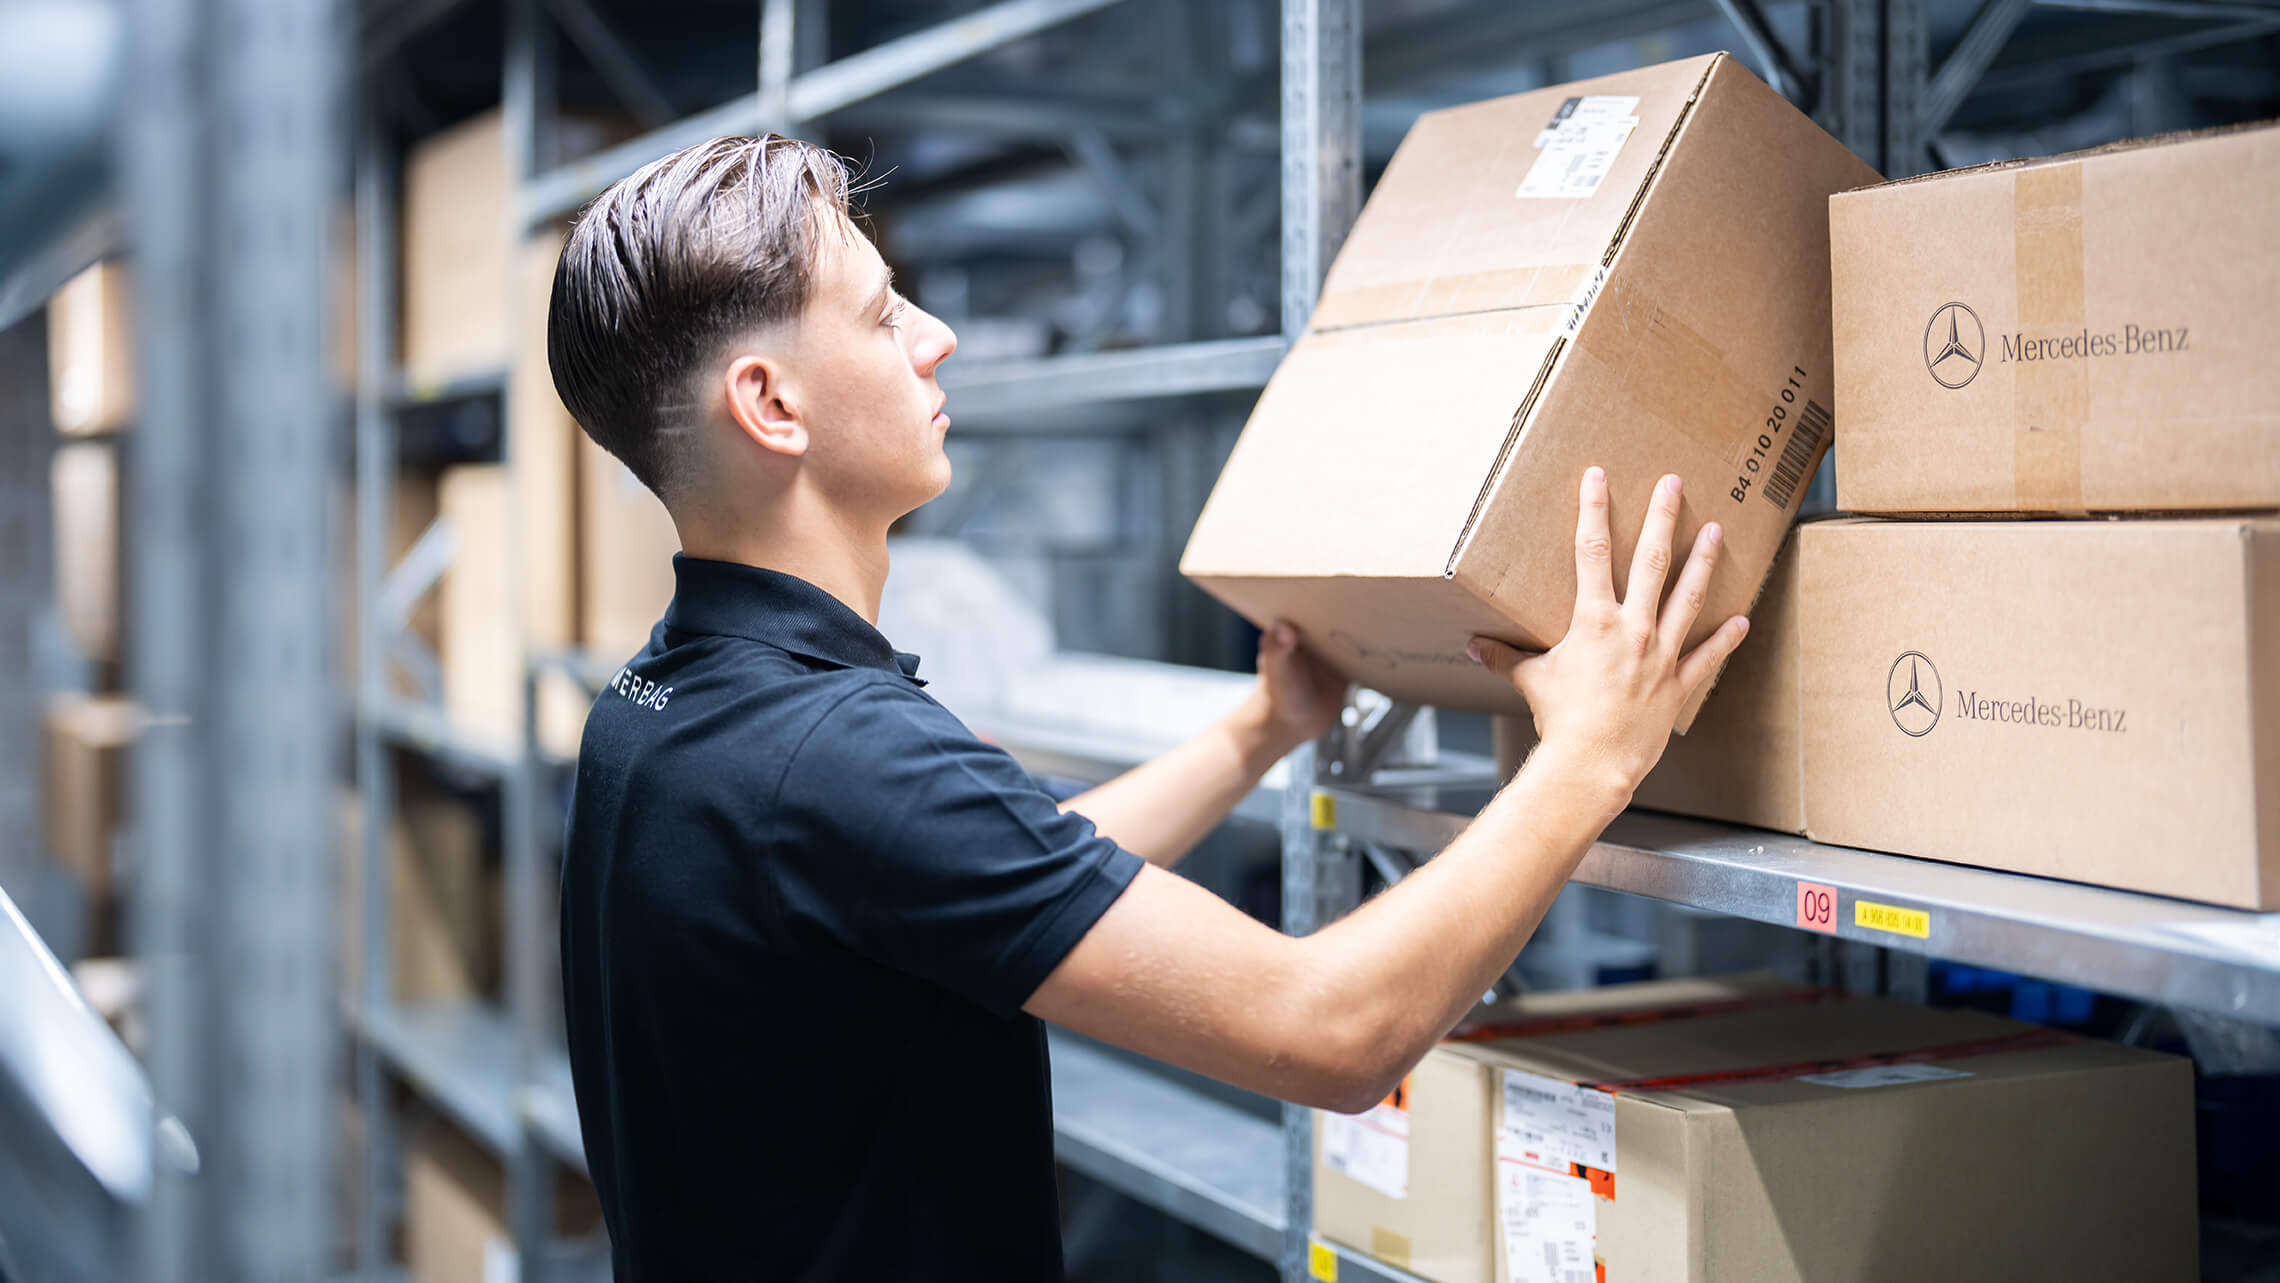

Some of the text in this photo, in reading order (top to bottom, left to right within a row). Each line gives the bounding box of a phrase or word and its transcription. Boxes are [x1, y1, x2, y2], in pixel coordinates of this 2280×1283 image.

[2001, 323, 2190, 363] Mercedes-Benz
[1730, 365, 1807, 503] B4 010 20 011
[1957, 690, 2127, 733] Mercedes-Benz
[1804, 890, 1830, 924] 09
